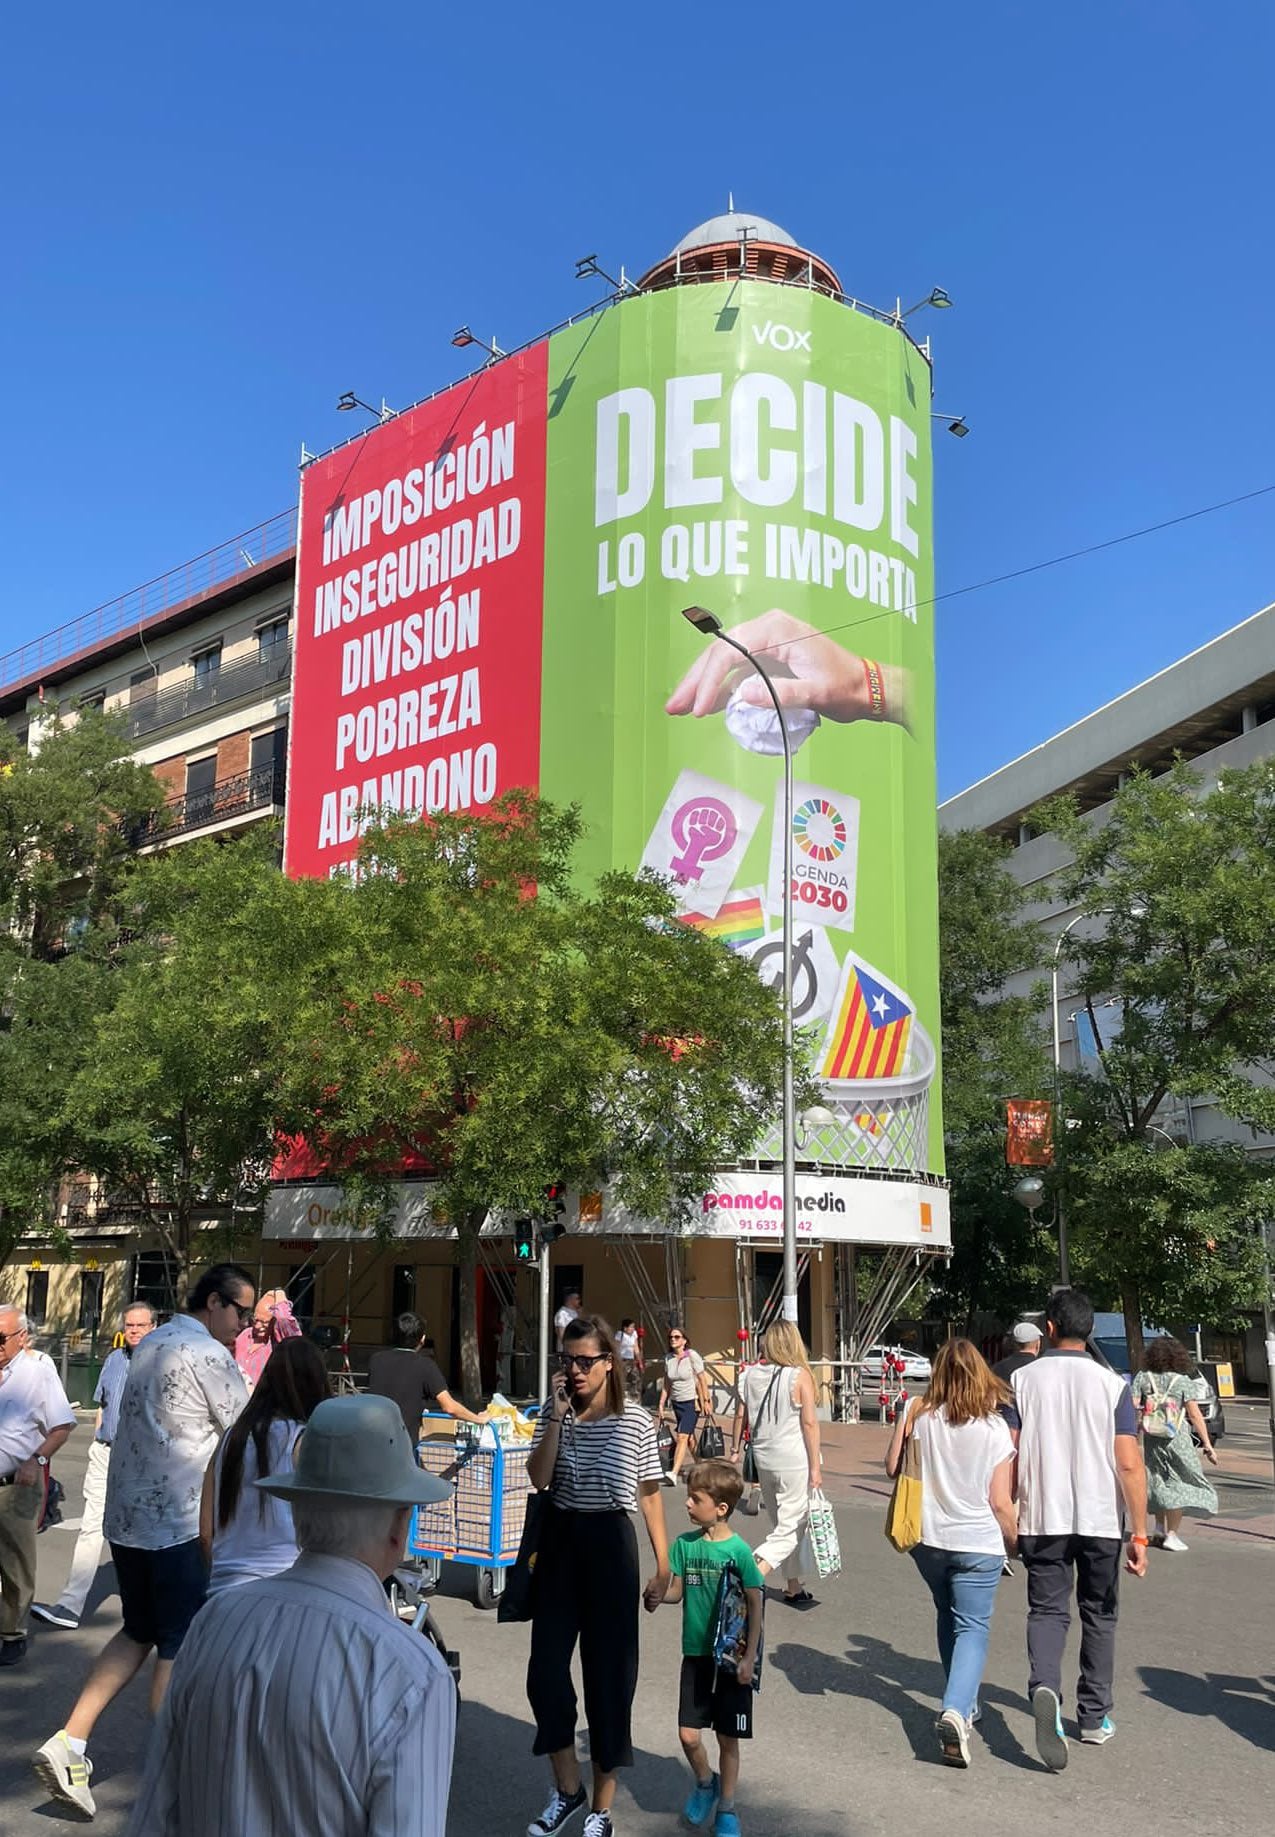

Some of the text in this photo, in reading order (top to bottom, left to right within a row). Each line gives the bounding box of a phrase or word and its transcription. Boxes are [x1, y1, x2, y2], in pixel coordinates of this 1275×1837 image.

[752, 320, 812, 352] VOX
[322, 420, 516, 567] IMPOSICIÓN
[595, 372, 919, 559] DECIDE
[314, 497, 521, 638] INSEGURIDAD
[598, 520, 917, 625] LO QUE IMPORTA
[341, 584, 481, 696] DIVISIÓN
[336, 667, 481, 771] POBREZA
[318, 743, 497, 849] ABANDONO
[782, 864, 848, 889] GENDA
[739, 1219, 752, 1230] 91
[756, 1220, 777, 1231] 633
[797, 1221, 812, 1232] 42
[736, 1713, 747, 1731] 10
